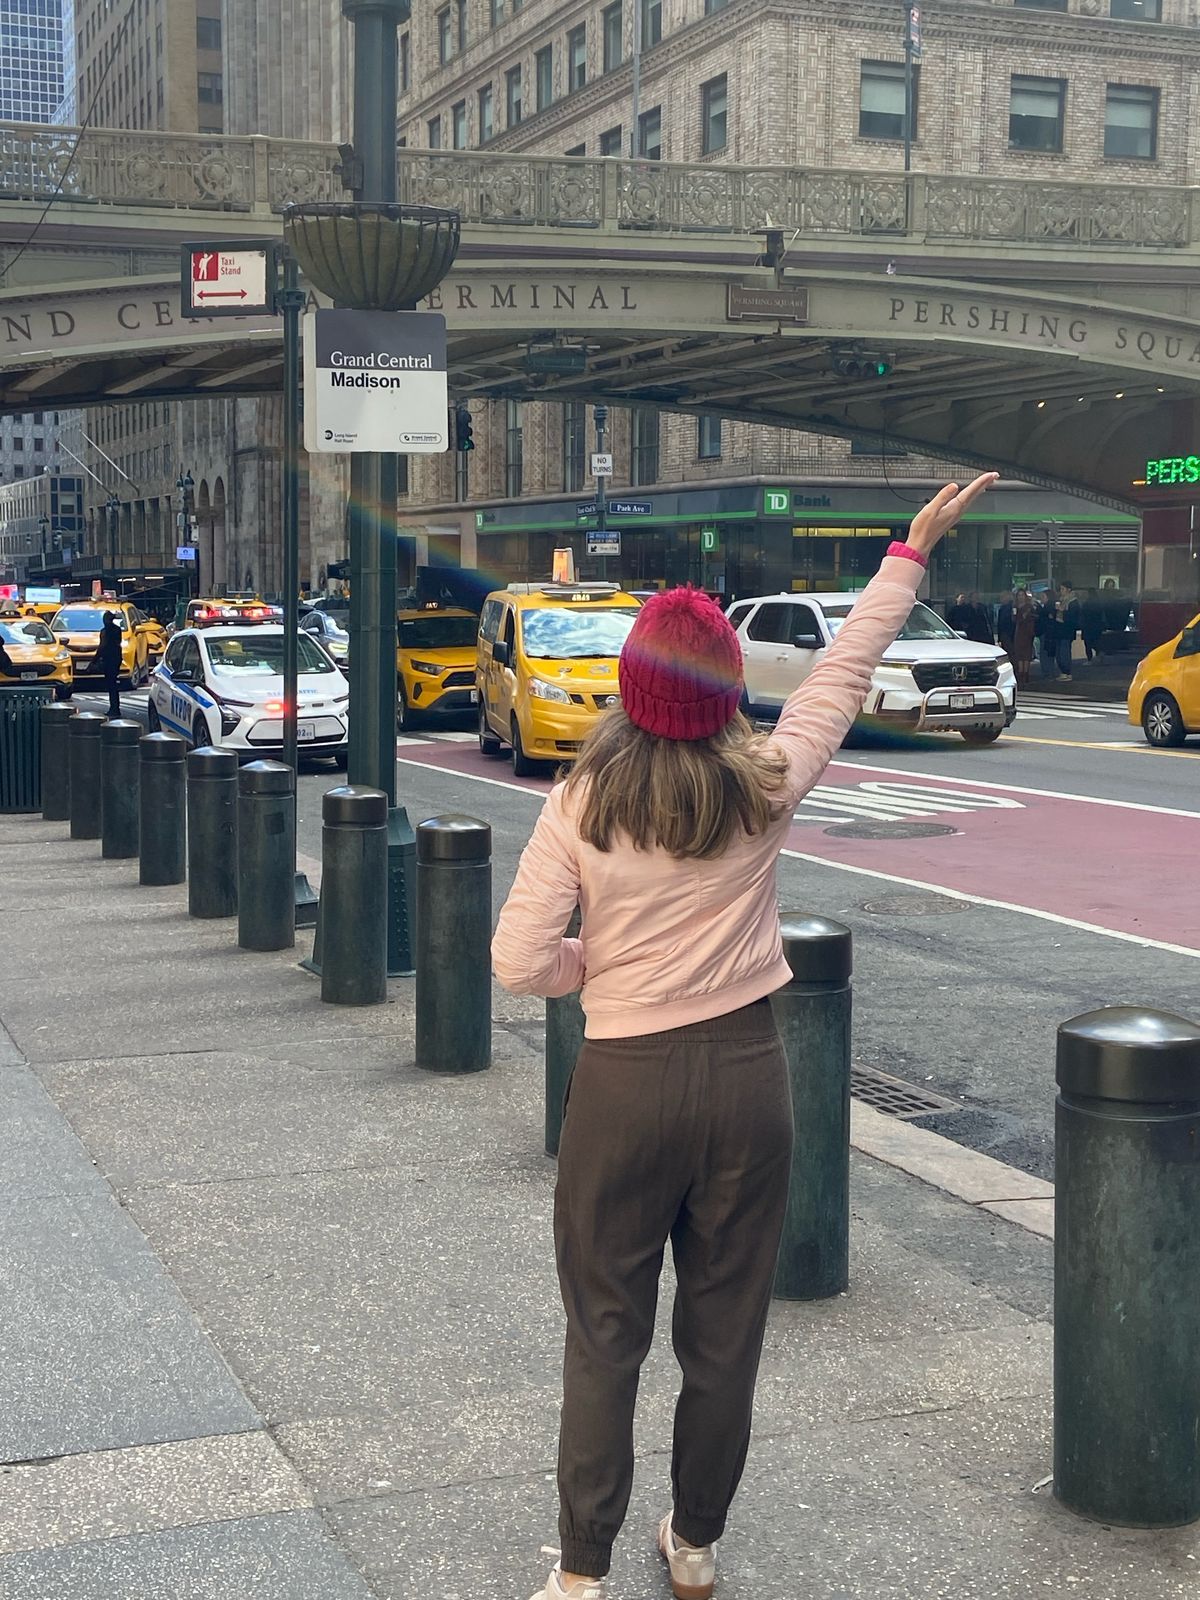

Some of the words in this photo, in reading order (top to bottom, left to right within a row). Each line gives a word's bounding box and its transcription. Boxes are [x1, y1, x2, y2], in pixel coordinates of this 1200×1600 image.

[220, 257, 235, 266] Taxi
[220, 266, 241, 275] Stand
[422, 284, 637, 310] ERMINAL
[889, 298, 1088, 343] PERSHING
[330, 351, 375, 367] Grand
[377, 353, 432, 368] Central
[331, 372, 400, 388] Madison
[616, 504, 631, 512] Park
[767, 493, 788, 510] TD
[793, 494, 831, 507] Bank
[703, 532, 714, 548] TD
[686, 1553, 704, 1562] NIKE
[582, 1588, 601, 1599] NIKE
